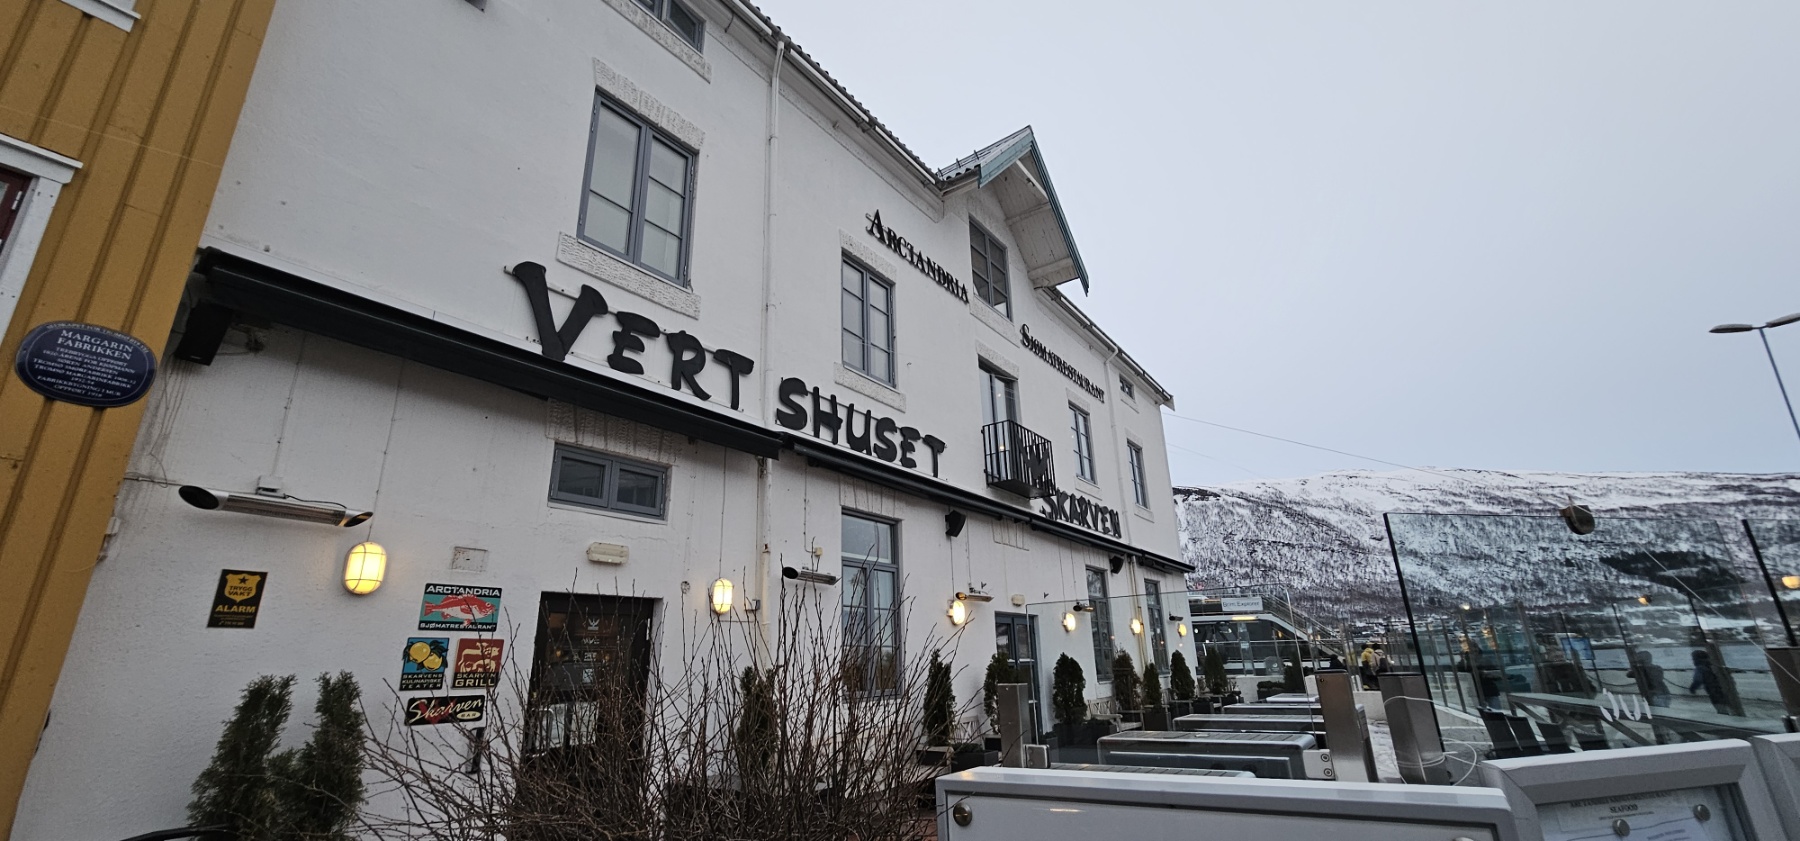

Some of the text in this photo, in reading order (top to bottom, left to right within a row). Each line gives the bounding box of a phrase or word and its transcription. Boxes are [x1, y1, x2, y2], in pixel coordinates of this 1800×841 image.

[866, 209, 970, 304] ARCTANDRIA
[57, 337, 132, 360] FABRIKKEN
[61, 329, 134, 353] MARGARIN
[1040, 488, 1122, 539] SKARVEN
[426, 585, 500, 596] ARCTANDRIA
[215, 605, 256, 613] ALARM
[455, 679, 496, 687] GRILL
[409, 698, 483, 723] Skarven
